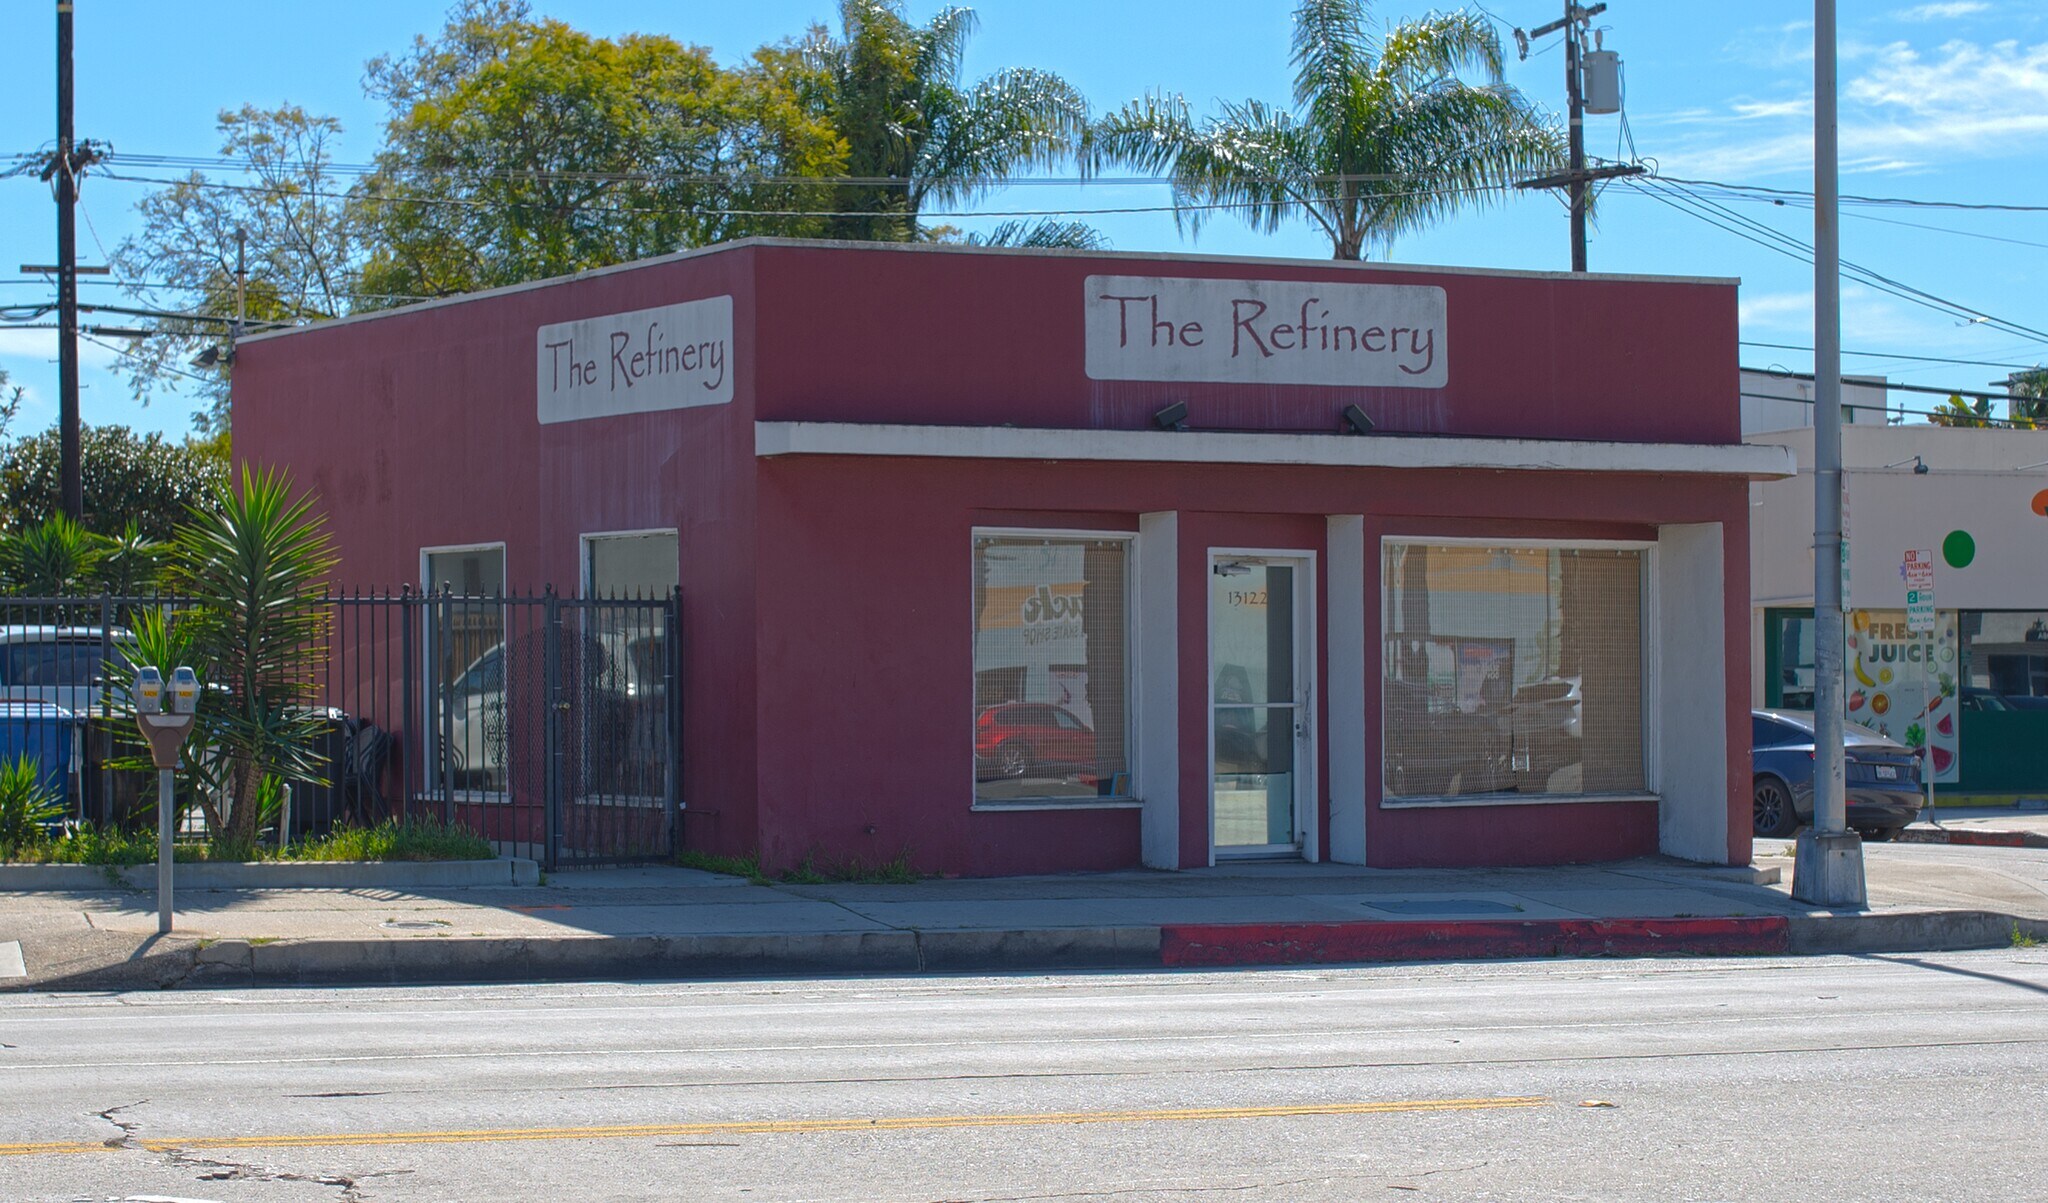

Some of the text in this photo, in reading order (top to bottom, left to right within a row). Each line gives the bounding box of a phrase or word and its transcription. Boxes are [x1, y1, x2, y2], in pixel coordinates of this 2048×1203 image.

[1100, 294, 1433, 374] The Refinery
[545, 322, 724, 392] The Refinery
[1905, 550, 1916, 561] NO
[1906, 561, 1931, 570] PARKING
[1228, 591, 1268, 607] 13122
[1908, 592, 1917, 602] 2
[1909, 605, 1934, 614] PARKING
[1868, 644, 1934, 662] JUICE
